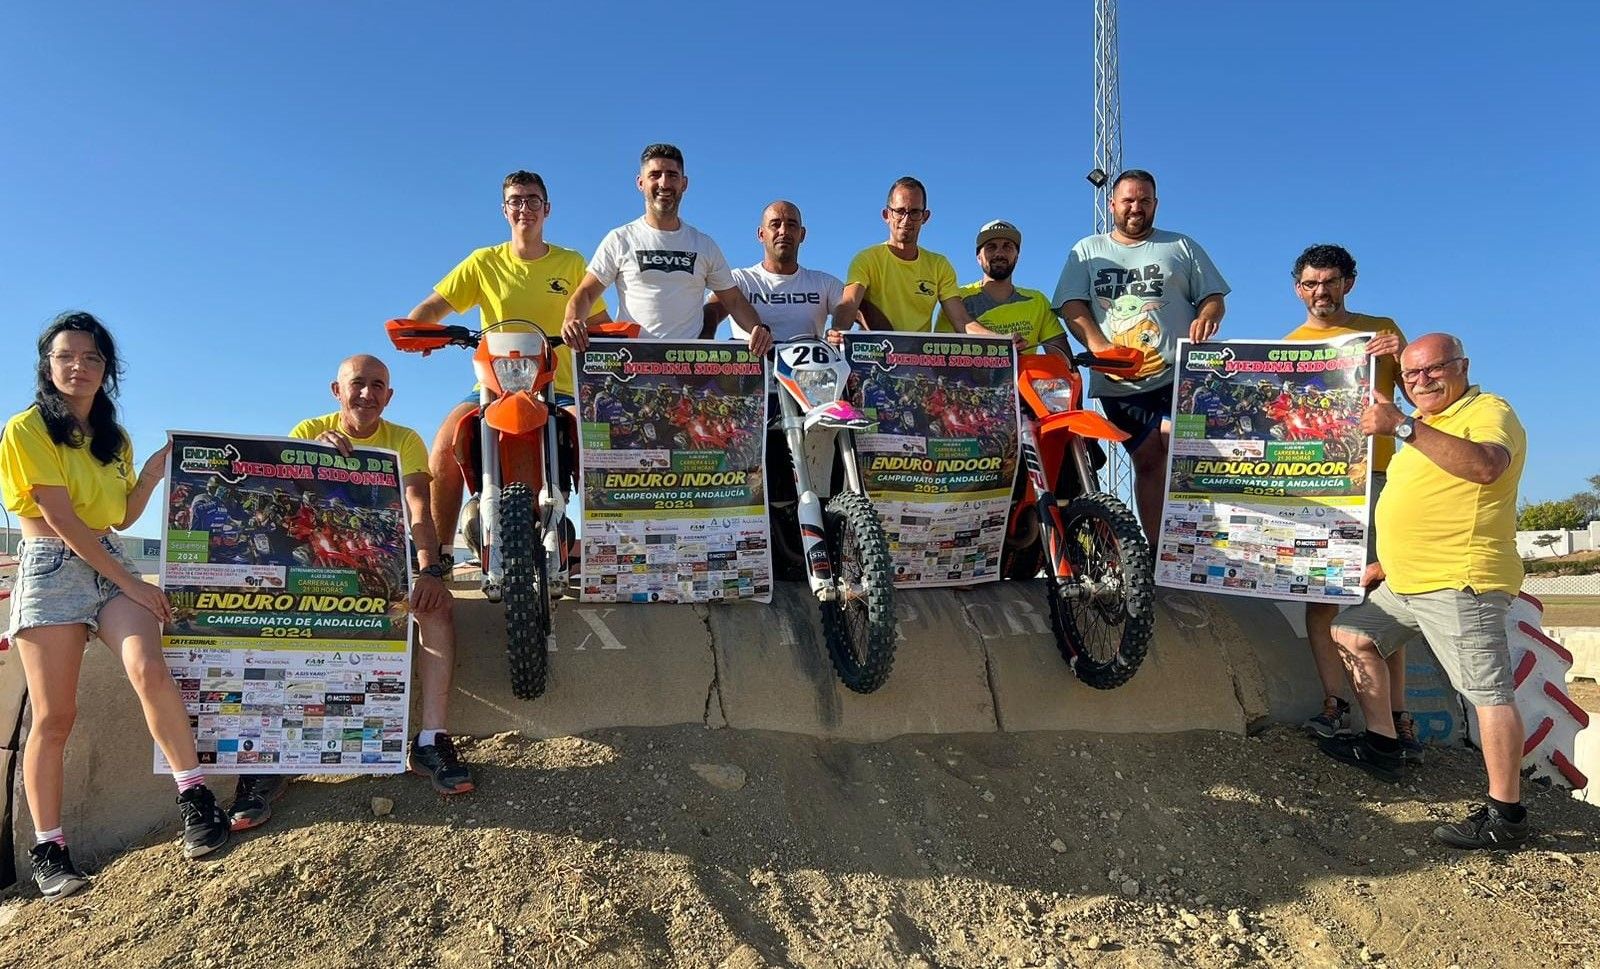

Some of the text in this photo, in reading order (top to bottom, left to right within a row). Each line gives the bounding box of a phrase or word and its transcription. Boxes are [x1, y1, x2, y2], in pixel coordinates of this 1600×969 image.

[1094, 264, 1164, 286] STAR
[1094, 281, 1164, 300] WARS
[922, 342, 1009, 356] CIUDAD DE
[1268, 349, 1337, 362] CIUDAD
[665, 350, 734, 362] CIUDAD
[792, 346, 829, 366] 26
[886, 353, 1012, 368] MEDINA SIDONIA
[624, 363, 762, 375] MEDINA SIDONIA
[1225, 356, 1367, 373] MEDINA SIDONIA
[184, 448, 226, 460] ENDURO
[281, 450, 394, 473] CIUDAD DE
[871, 457, 933, 472] ENDURO
[936, 457, 1002, 473] INDOOR
[231, 461, 397, 487] MEDINA SIDONIA
[1194, 462, 1270, 476] ENDURO
[1273, 461, 1348, 476] INDOOR
[605, 473, 676, 488] ENDURO
[681, 471, 747, 487] INDOOR
[877, 473, 998, 485] CAMPEONATO DE ANDALUCÍA
[1201, 478, 1269, 487] CAMPEONATO
[1287, 478, 1344, 487] ANDALUCÍA
[613, 489, 745, 500] CAMPEONATO DE ANDALUCÍA
[914, 484, 949, 493] 2024
[1243, 487, 1285, 496] 2024
[654, 500, 694, 509] 2024
[196, 593, 294, 612] ENDURO
[298, 595, 387, 613] INDOOR
[207, 615, 383, 628] CAMPEONATO DE ANDALUCÍA
[260, 628, 313, 638] 2024
